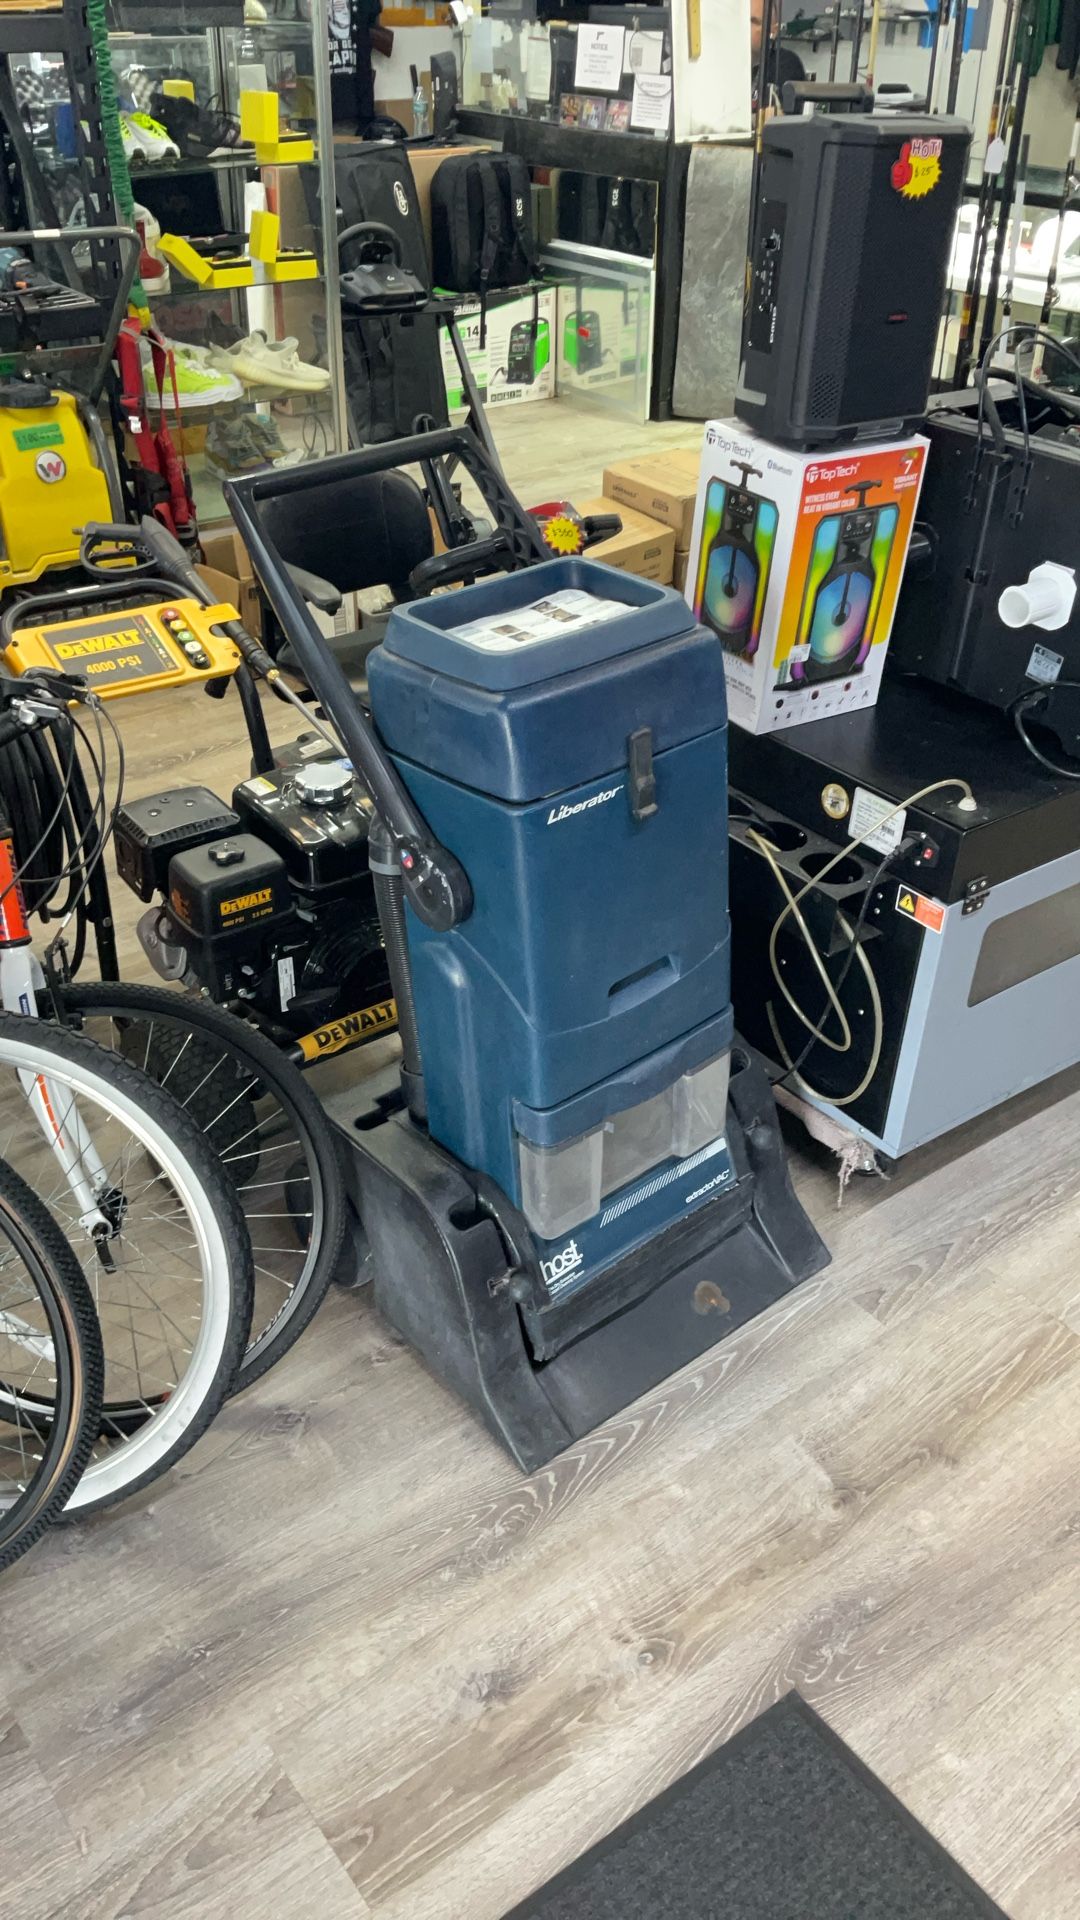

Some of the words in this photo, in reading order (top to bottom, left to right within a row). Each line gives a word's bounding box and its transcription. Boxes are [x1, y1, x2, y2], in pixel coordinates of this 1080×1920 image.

[904, 460, 913, 474] 7
[86, 660, 117, 674] 4000
[118, 655, 142, 668] PSI
[547, 786, 622, 825] Liberator
